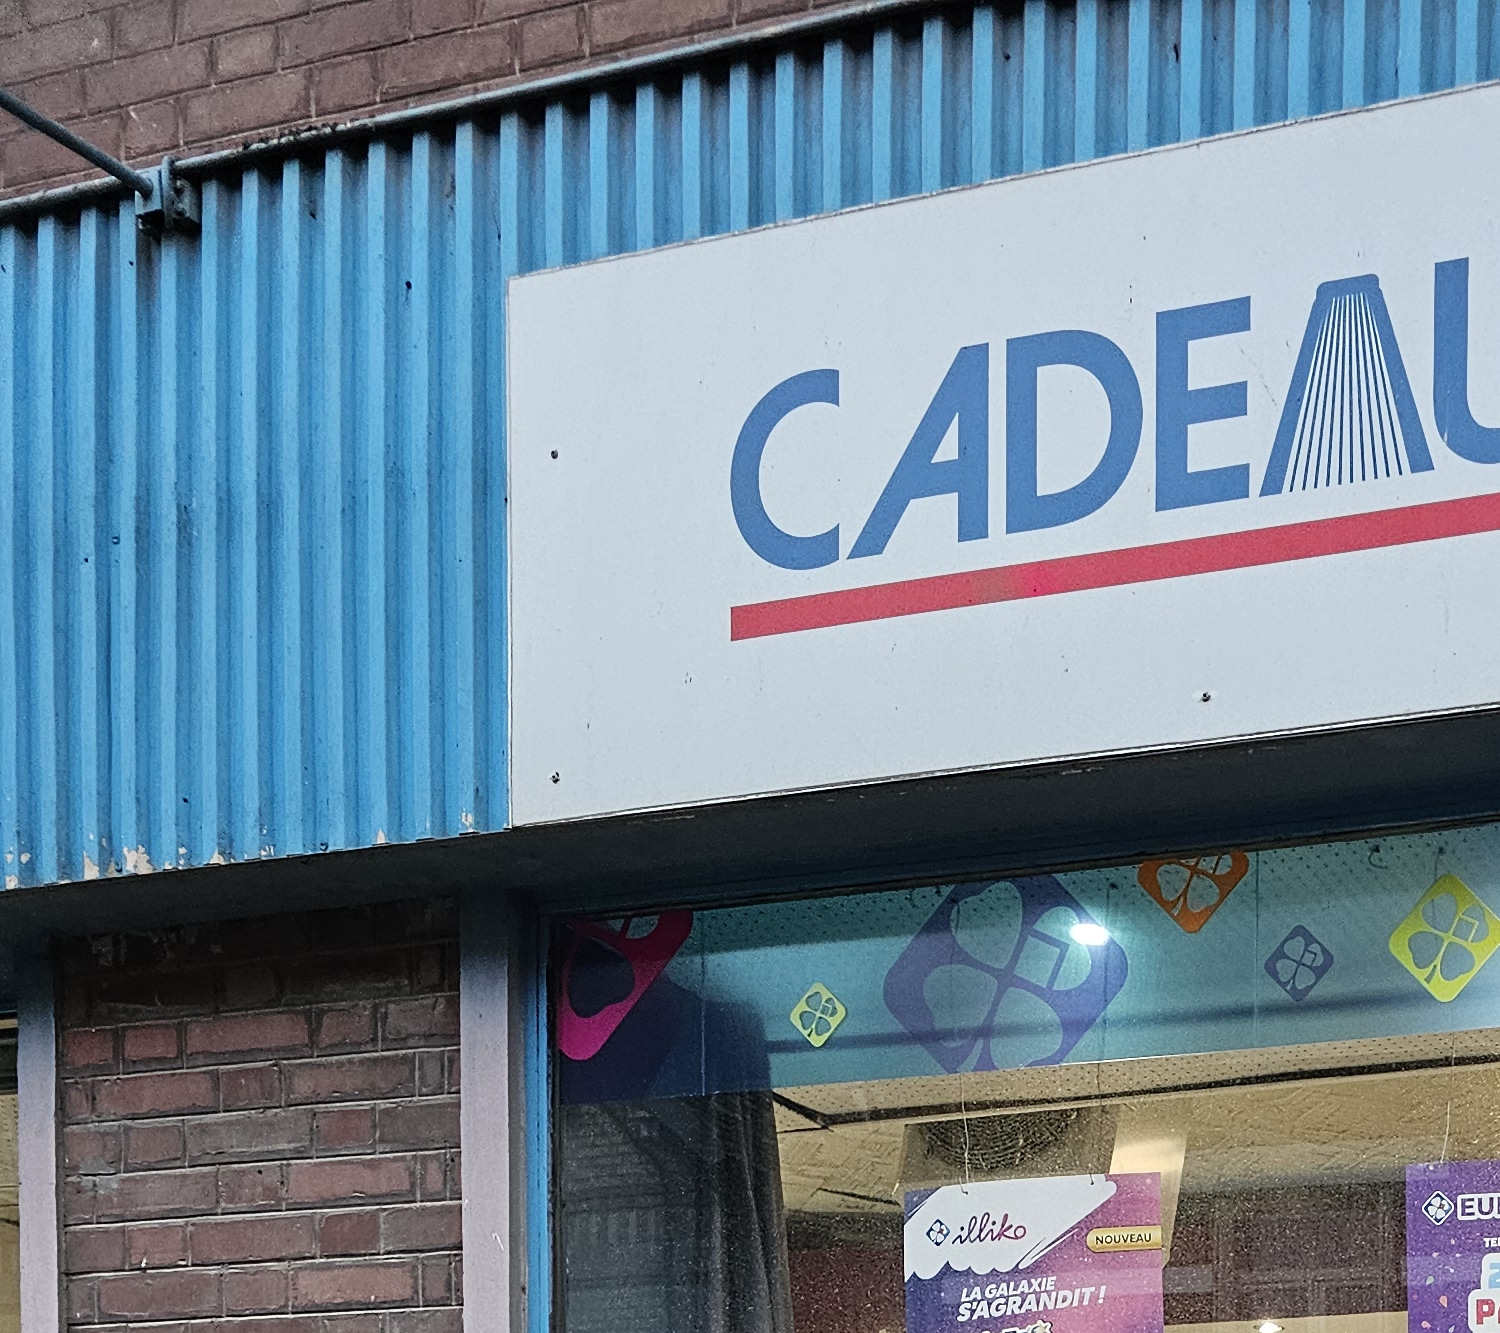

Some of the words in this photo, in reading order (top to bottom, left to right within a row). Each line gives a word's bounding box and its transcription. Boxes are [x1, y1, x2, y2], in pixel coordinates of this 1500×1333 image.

[952, 1212, 1026, 1244] illiko
[1096, 1233, 1152, 1244] NOUVEAU
[960, 1288, 981, 1301] LA
[984, 1276, 1056, 1298] GALAXIE
[957, 1286, 1096, 1322] S'AGRANDIT
